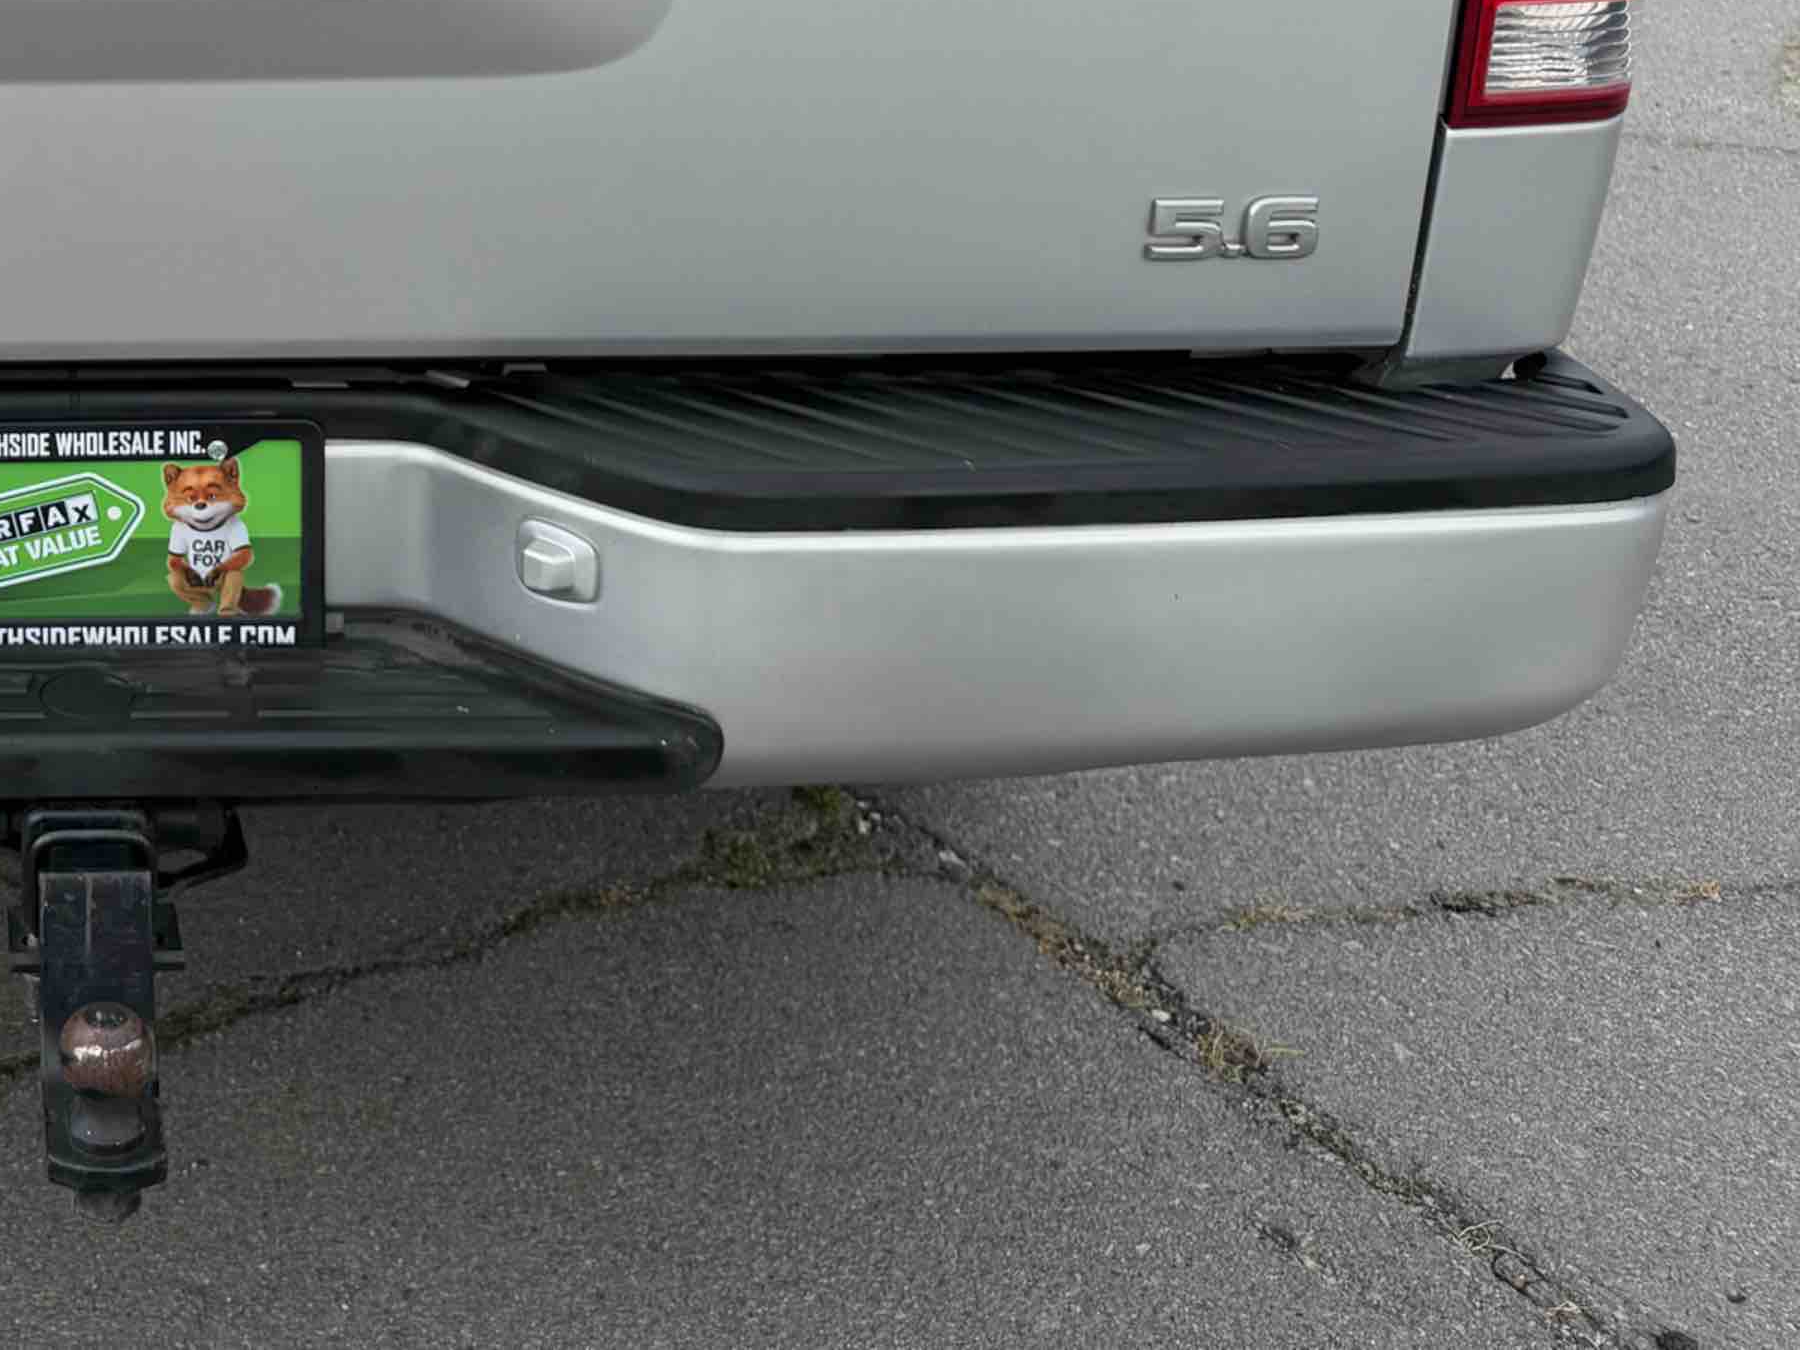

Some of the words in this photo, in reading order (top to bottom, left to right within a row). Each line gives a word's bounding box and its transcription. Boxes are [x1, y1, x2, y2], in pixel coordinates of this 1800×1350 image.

[1143, 195, 1319, 261] 5.6
[55, 431, 165, 457] WHOLESALE
[169, 430, 207, 455] INC.
[24, 524, 103, 561] VALUE
[192, 538, 225, 554] CAR
